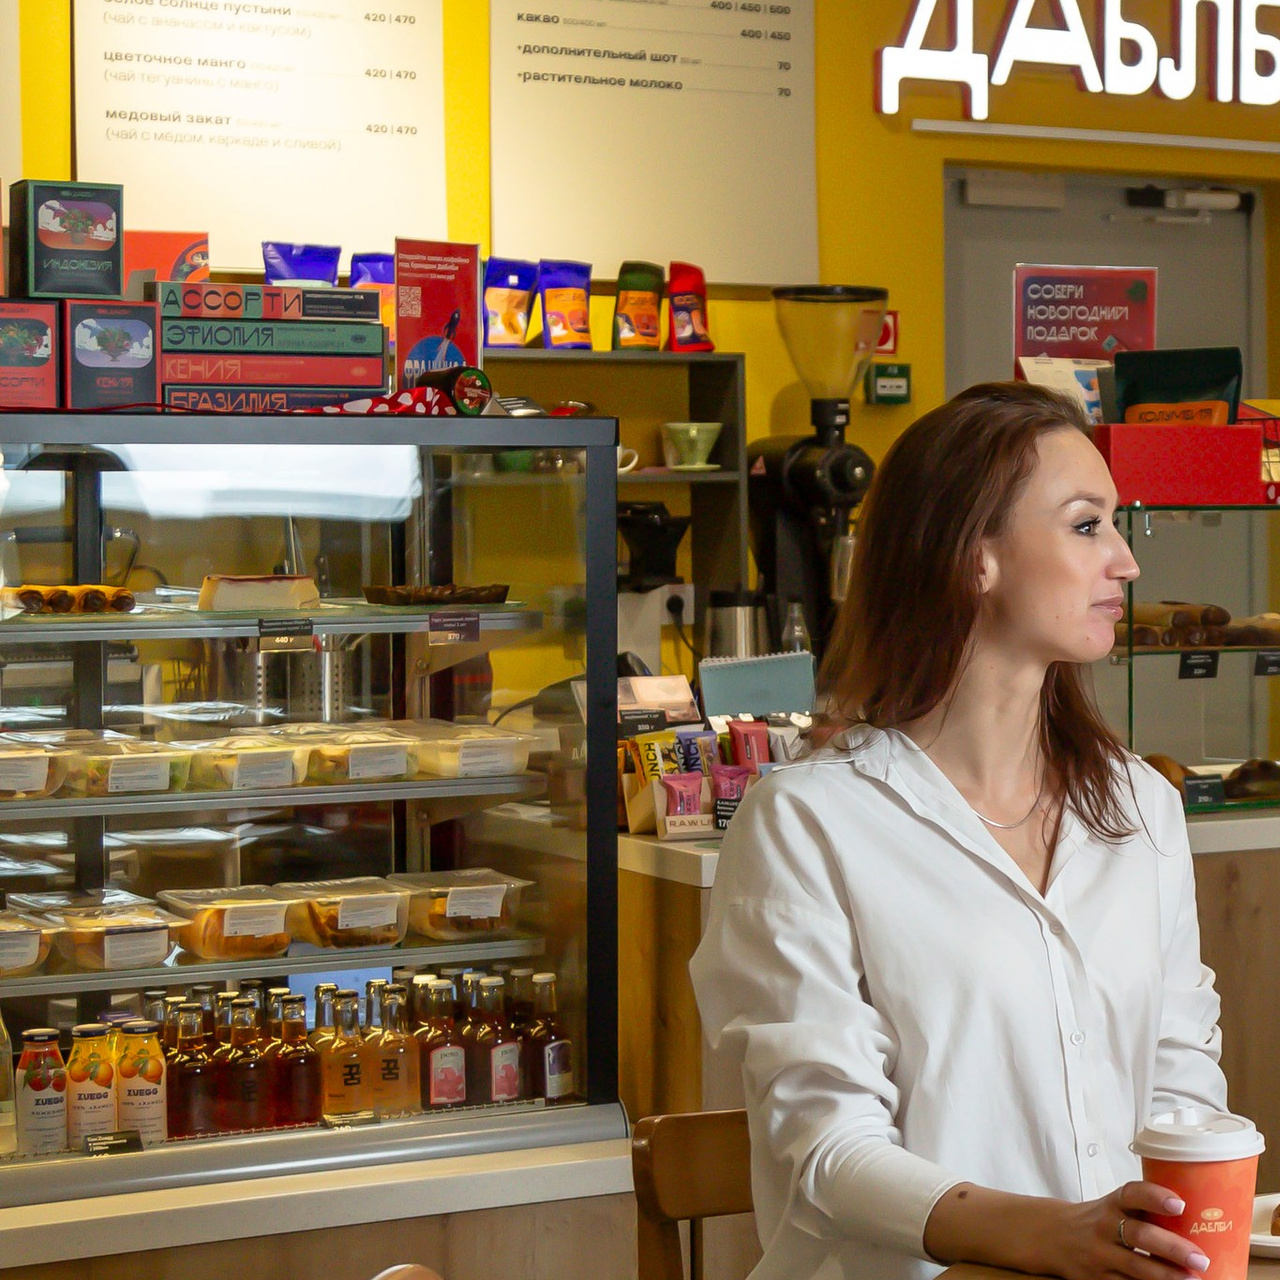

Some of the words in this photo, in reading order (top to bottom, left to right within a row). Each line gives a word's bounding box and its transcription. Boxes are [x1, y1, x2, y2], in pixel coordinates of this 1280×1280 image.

[223, 1, 292, 16] пустыни
[364, 12, 386, 23] 420
[394, 15, 416, 25] 470
[711, 1, 733, 10] 400
[740, 3, 761, 12] 450
[517, 11, 560, 24] какао
[741, 29, 762, 39] 400
[770, 31, 791, 41] 450
[103, 51, 193, 67] цветочное
[197, 57, 246, 69] манго
[365, 68, 387, 78] 420
[395, 70, 416, 80] 470
[650, 53, 678, 64] шот
[630, 77, 683, 90] молоко
[105, 108, 182, 124] медовый
[186, 113, 232, 125] закат
[366, 124, 388, 134] 420
[396, 126, 418, 136] 470
[163, 289, 301, 313] АССОРТИ
[1027, 283, 1084, 299] СОБЕРИ
[1027, 304, 1129, 322] НОВОГОДНИЙ
[167, 324, 274, 348] ЭФИОПИЯ
[1027, 326, 1099, 342] ПОДАРОК
[166, 359, 241, 380] КЕНИЯ
[170, 392, 287, 412] БРАЗИЛИЯ
[343, 1063, 362, 1086] 꿈
[382, 1058, 399, 1081] 꿈
[77, 1091, 109, 1101] ZUEGG
[127, 1087, 158, 1097] ZUEGG
[1189, 1220, 1233, 1235] ДАБЛБИ
